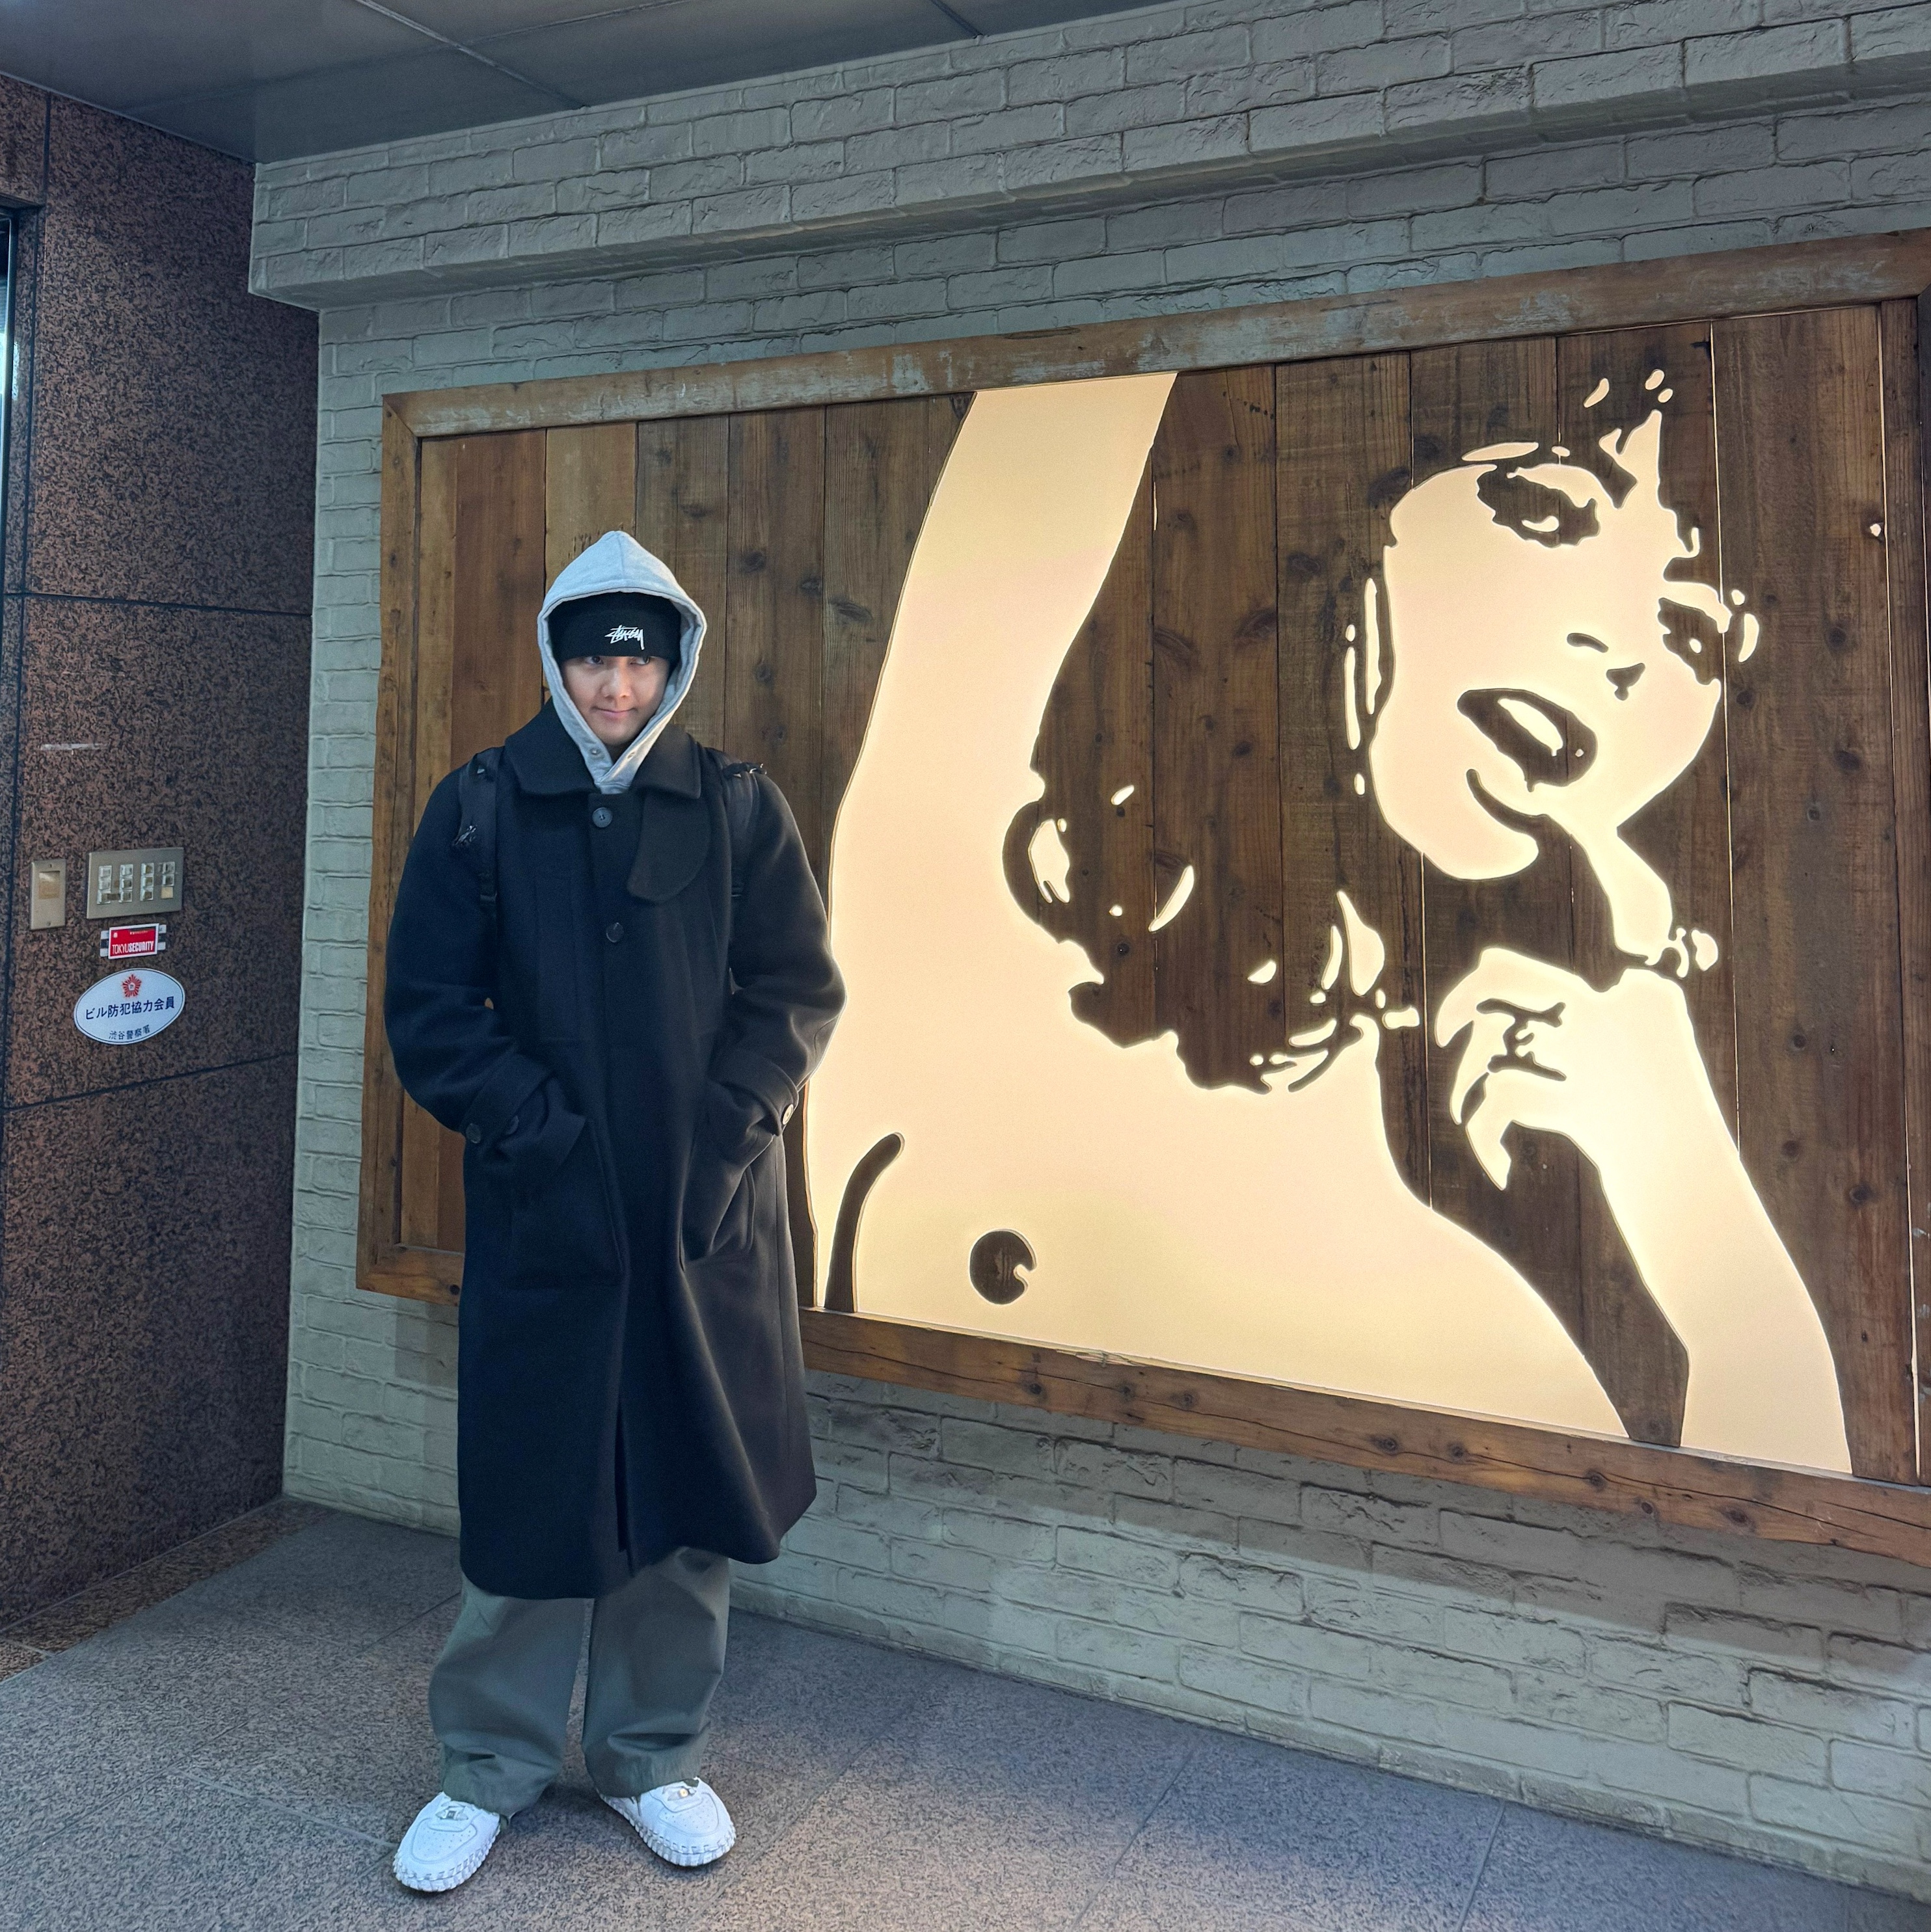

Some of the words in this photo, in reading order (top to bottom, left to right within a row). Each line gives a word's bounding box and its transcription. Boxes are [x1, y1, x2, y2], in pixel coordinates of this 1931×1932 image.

[86, 996, 174, 1020] ビル防犯協力会員
